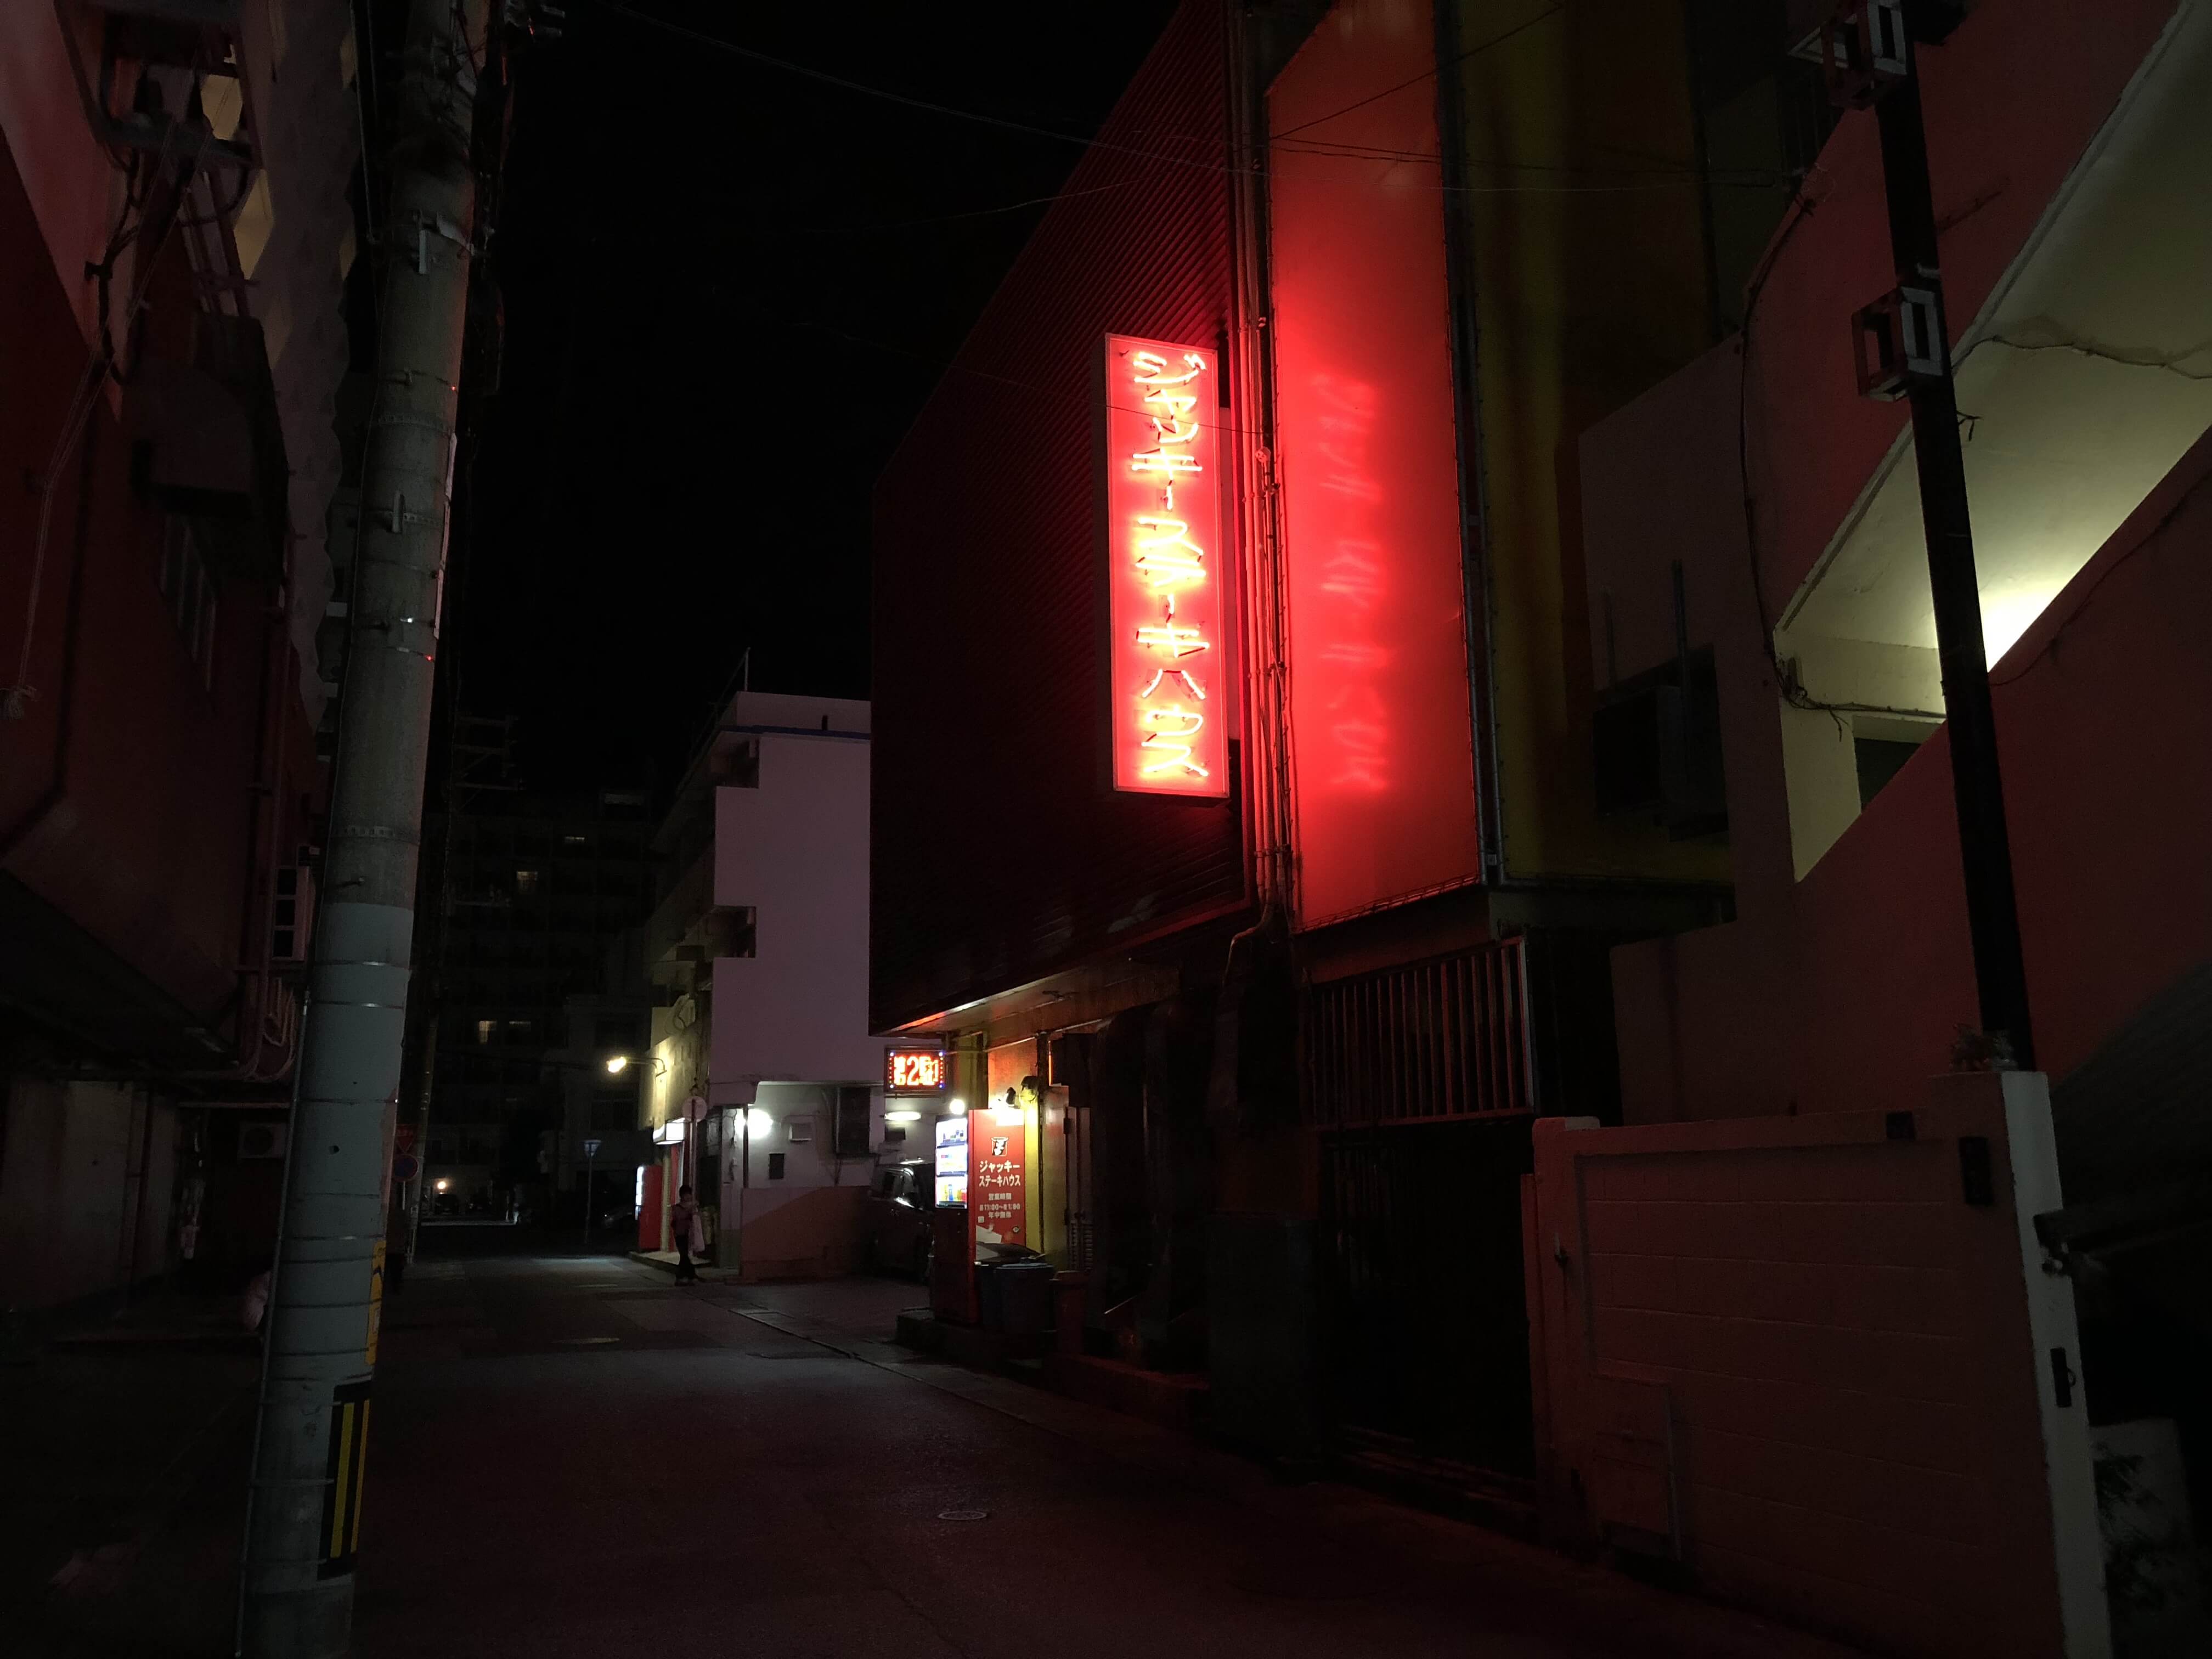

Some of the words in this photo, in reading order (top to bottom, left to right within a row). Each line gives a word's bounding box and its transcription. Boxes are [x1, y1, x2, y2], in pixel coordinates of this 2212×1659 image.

[1131, 351, 1210, 779] ジャッキーステーキハウス
[979, 1160, 1020, 1173] ジャッキー
[979, 1174, 1021, 1187] ステーキハウス
